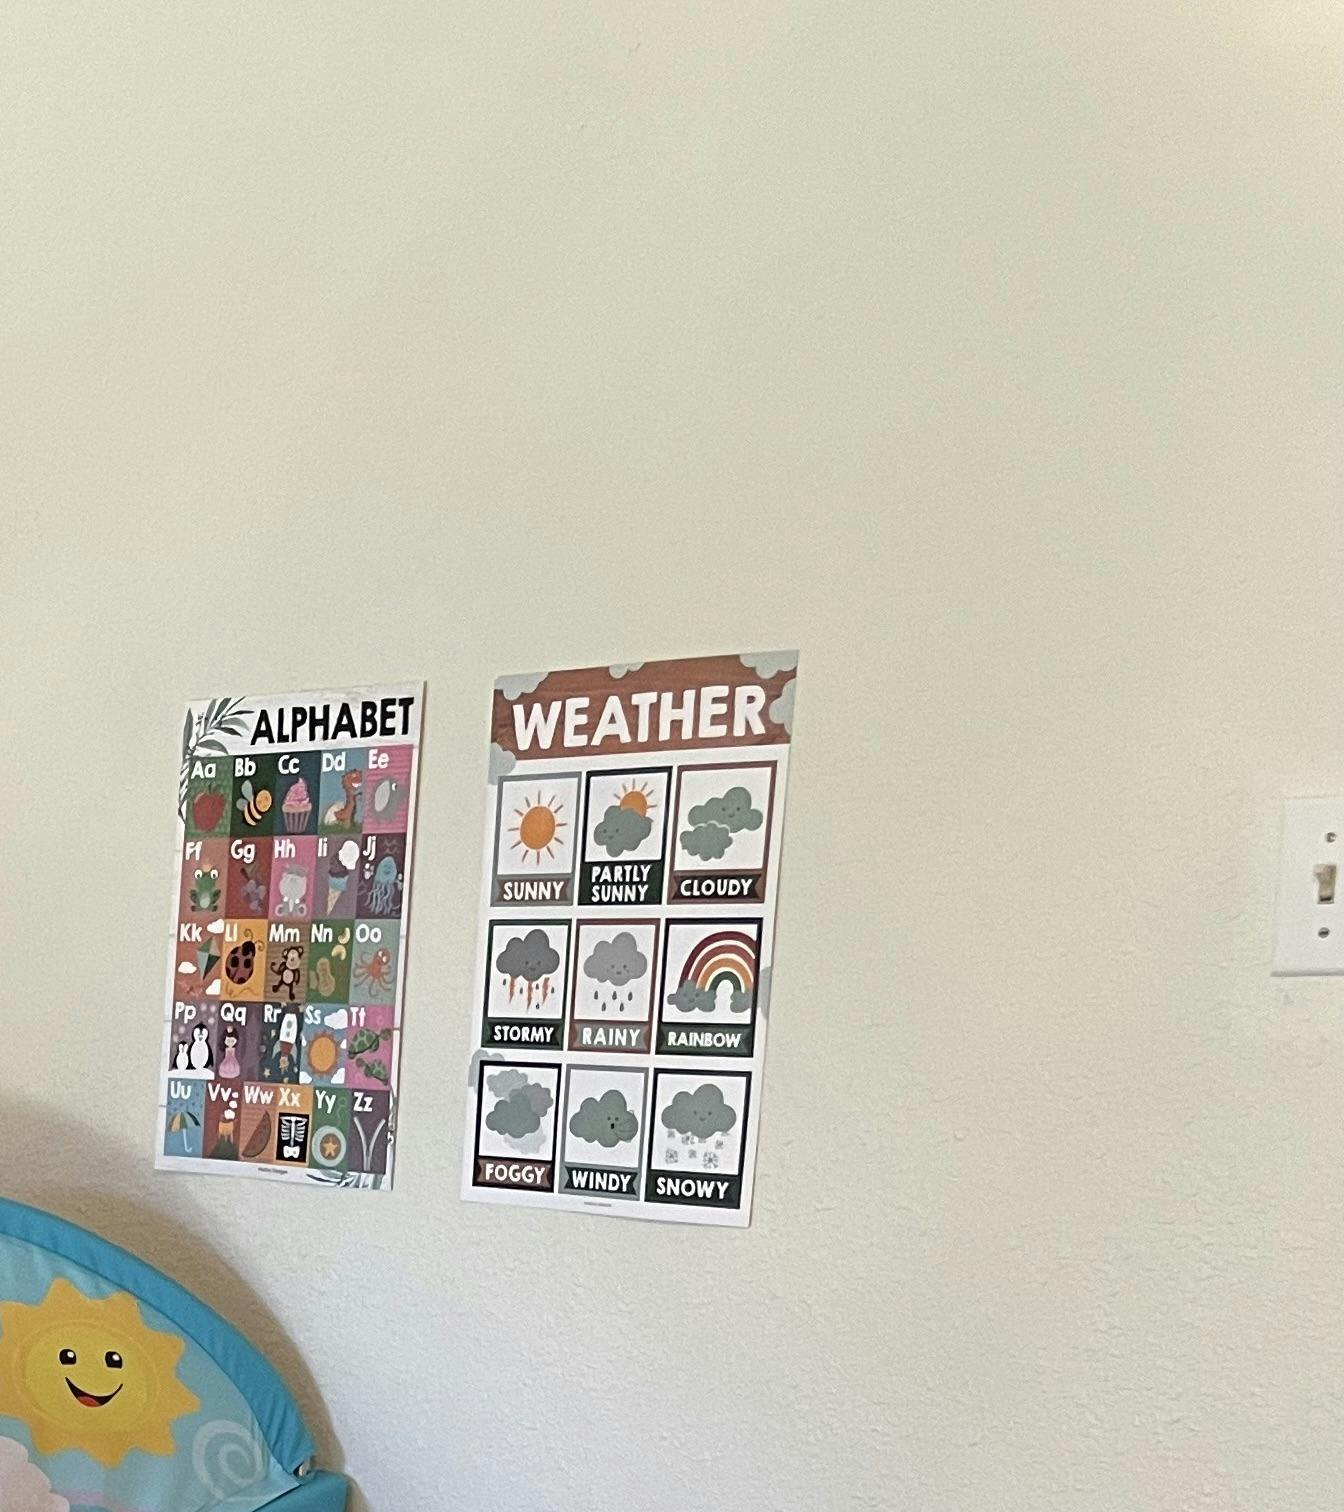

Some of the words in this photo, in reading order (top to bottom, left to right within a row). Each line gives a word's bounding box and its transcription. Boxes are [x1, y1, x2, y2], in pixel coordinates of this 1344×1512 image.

[250, 697, 414, 745] ALPHABET
[513, 685, 766, 751] WEATHER
[190, 758, 216, 779] Aa
[235, 757, 256, 777] Bb
[279, 755, 300, 774] Cc
[322, 752, 345, 773] Dd
[369, 750, 389, 769] Ee
[186, 841, 202, 862] Ff
[231, 840, 255, 864] Gg
[274, 838, 296, 859] Hh
[363, 836, 376, 860] Jj
[592, 865, 651, 883] PARTLY
[504, 881, 564, 901] SUNNY
[592, 883, 648, 903] SUNNY
[680, 876, 753, 896] CLOUDY
[179, 922, 203, 942] Kk
[269, 922, 300, 942] Mm
[311, 921, 333, 941] Nn
[355, 923, 382, 943] Oo
[174, 1002, 196, 1026] Pp
[220, 1004, 246, 1027] Qq
[263, 1004, 281, 1024] Rr
[305, 1005, 322, 1024] Ss
[349, 1006, 366, 1025] Tt
[493, 1024, 554, 1043] STORMY
[582, 1027, 640, 1046] RAINY
[668, 1032, 741, 1048] RAINBOW
[170, 1080, 192, 1099] Uu
[208, 1082, 231, 1102] Vv
[244, 1088, 273, 1105] Ww
[279, 1087, 301, 1107] Xx
[315, 1090, 336, 1114] Yy
[353, 1091, 374, 1112] Zz
[485, 1164, 545, 1185] FOGGY
[572, 1170, 631, 1192] WINDY
[656, 1176, 728, 1200] SNOWY
